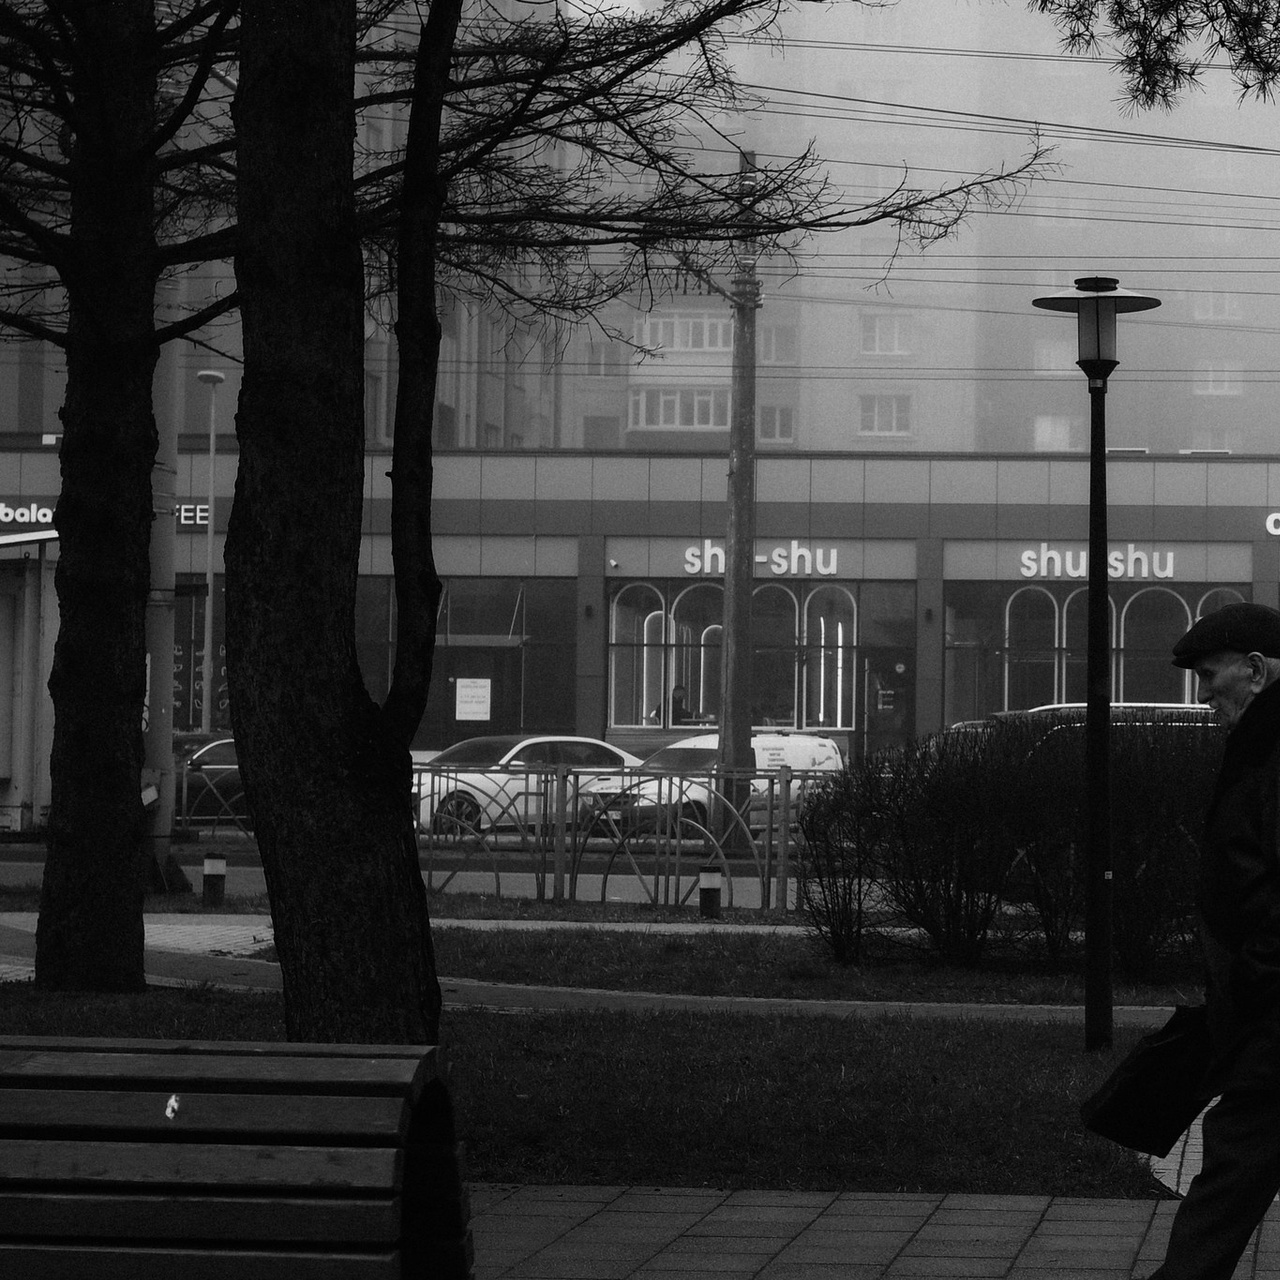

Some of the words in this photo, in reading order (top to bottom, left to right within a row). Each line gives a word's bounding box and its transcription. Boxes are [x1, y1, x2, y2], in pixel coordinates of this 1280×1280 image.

[0, 503, 56, 523] bala
[684, 539, 838, 575] sh-shu
[1020, 542, 1174, 579] shushu
